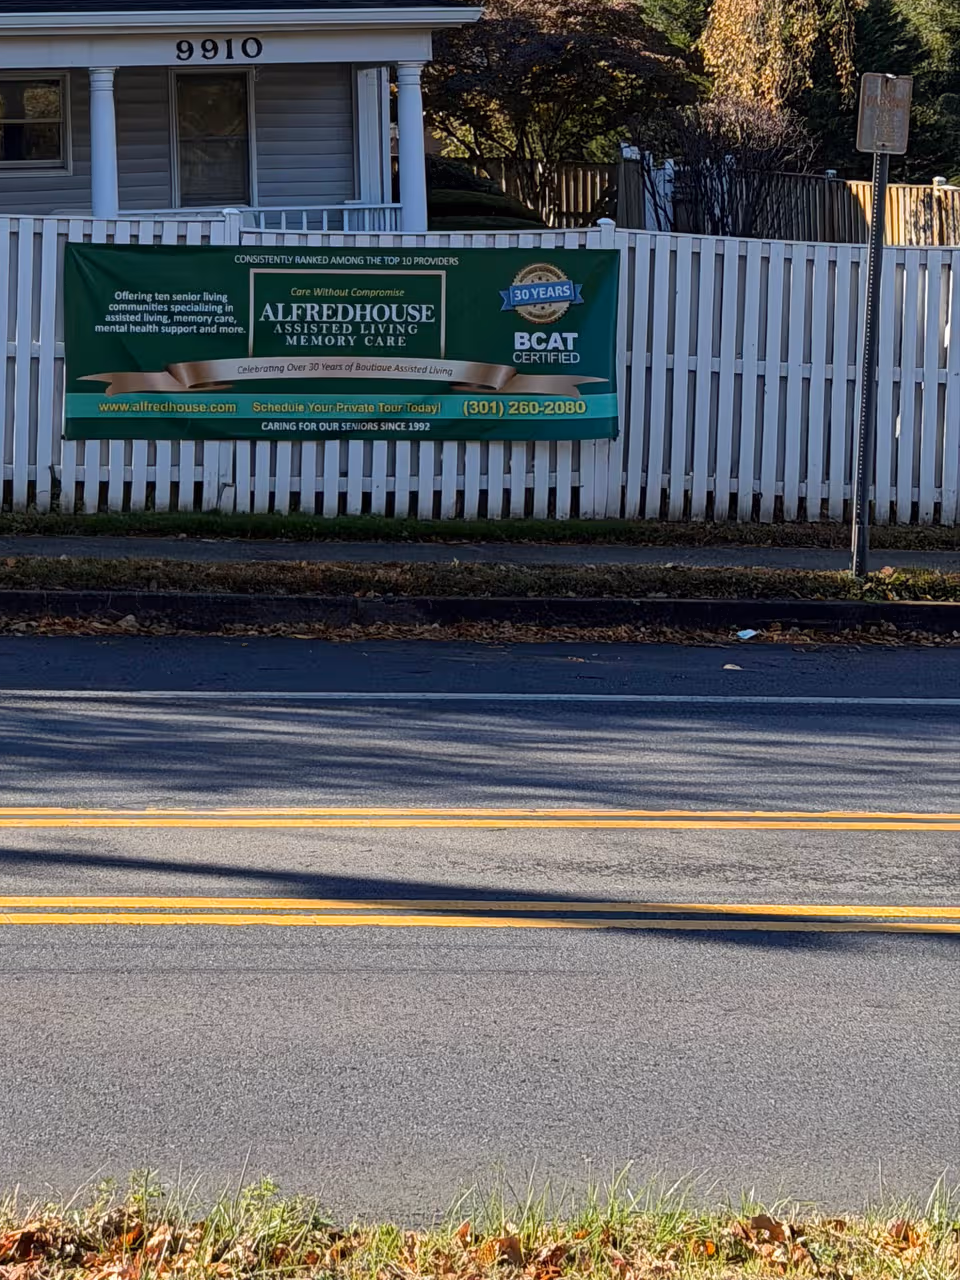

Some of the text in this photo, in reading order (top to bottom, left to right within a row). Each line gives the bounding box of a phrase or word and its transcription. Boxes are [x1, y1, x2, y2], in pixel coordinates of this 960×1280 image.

[176, 37, 262, 61] 9910
[234, 255, 459, 265] CONSISTENTLY RANKED AMONG THE TOP 10 PROVIDERS
[114, 291, 228, 303] Offering ten senior living
[291, 288, 405, 298] Care Without Compromise
[514, 285, 570, 300] 30 YEARS
[109, 303, 168, 311] communities
[170, 303, 223, 313] specializing
[259, 303, 435, 322] ALFREDHOUSE
[105, 313, 237, 324] assisted living, memory care,
[95, 324, 127, 332] mental
[130, 325, 158, 333] health
[161, 325, 197, 334] support
[199, 325, 217, 333] and
[273, 324, 419, 334] ASSISTED LIVING
[286, 335, 407, 346] MEMORY CARE
[514, 332, 578, 350] BCAT
[513, 352, 580, 363] CERTIFIED
[237, 364, 285, 374] Celebrating
[287, 363, 306, 371] Over
[309, 363, 319, 371] 30
[322, 362, 342, 371] Years
[344, 362, 354, 371] of
[394, 364, 428, 374] Assisted
[429, 365, 453, 376] Living
[99, 401, 236, 412] www.alfredhouse.com
[252, 402, 441, 414] Schedule Your Private Tour Today!
[463, 400, 586, 417] (301) 260-2080
[261, 422, 430, 431] CARING FOR OUR SENIORS SINCE 1992
